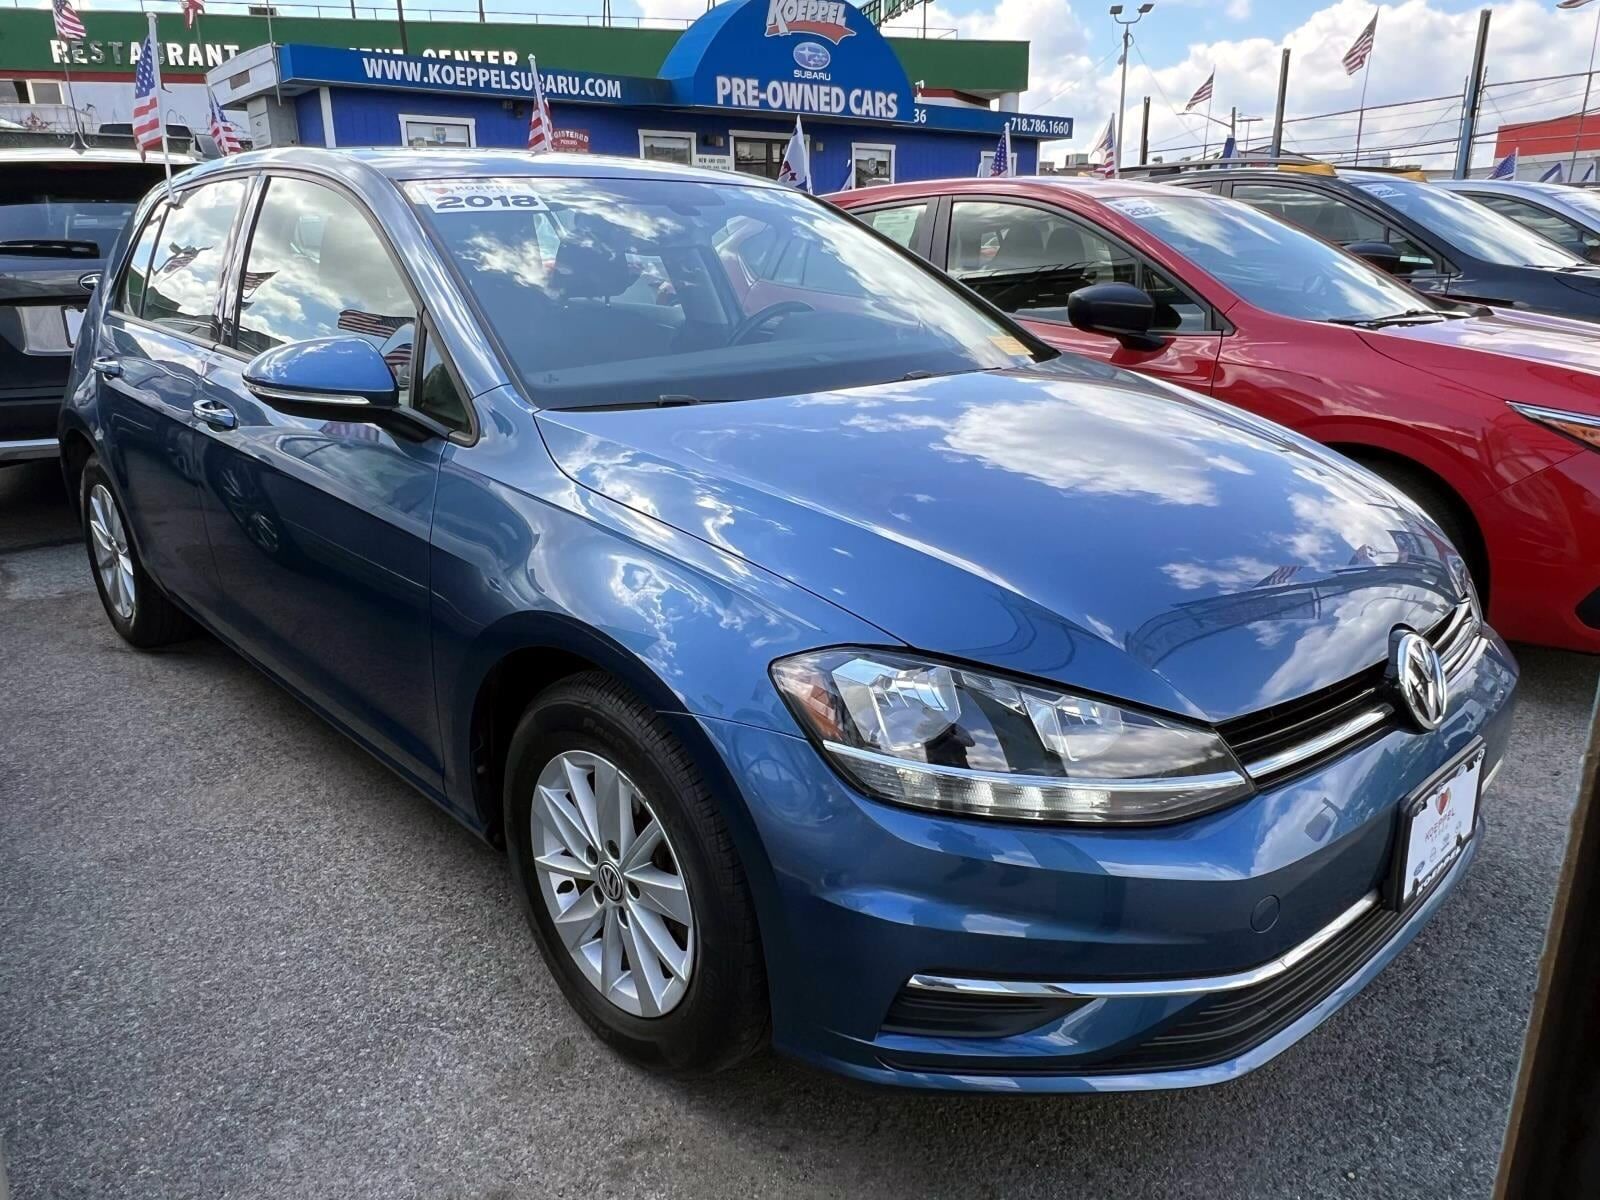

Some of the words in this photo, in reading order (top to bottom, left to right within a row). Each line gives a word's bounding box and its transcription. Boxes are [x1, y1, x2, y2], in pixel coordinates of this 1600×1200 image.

[766, 0, 847, 36] KOEPPEL
[793, 69, 832, 81] SUBARU
[716, 76, 846, 114] PRE-OWNED
[849, 88, 899, 119] CARS
[1010, 117, 1069, 135] 718.786.1660
[435, 194, 540, 210] 2018
